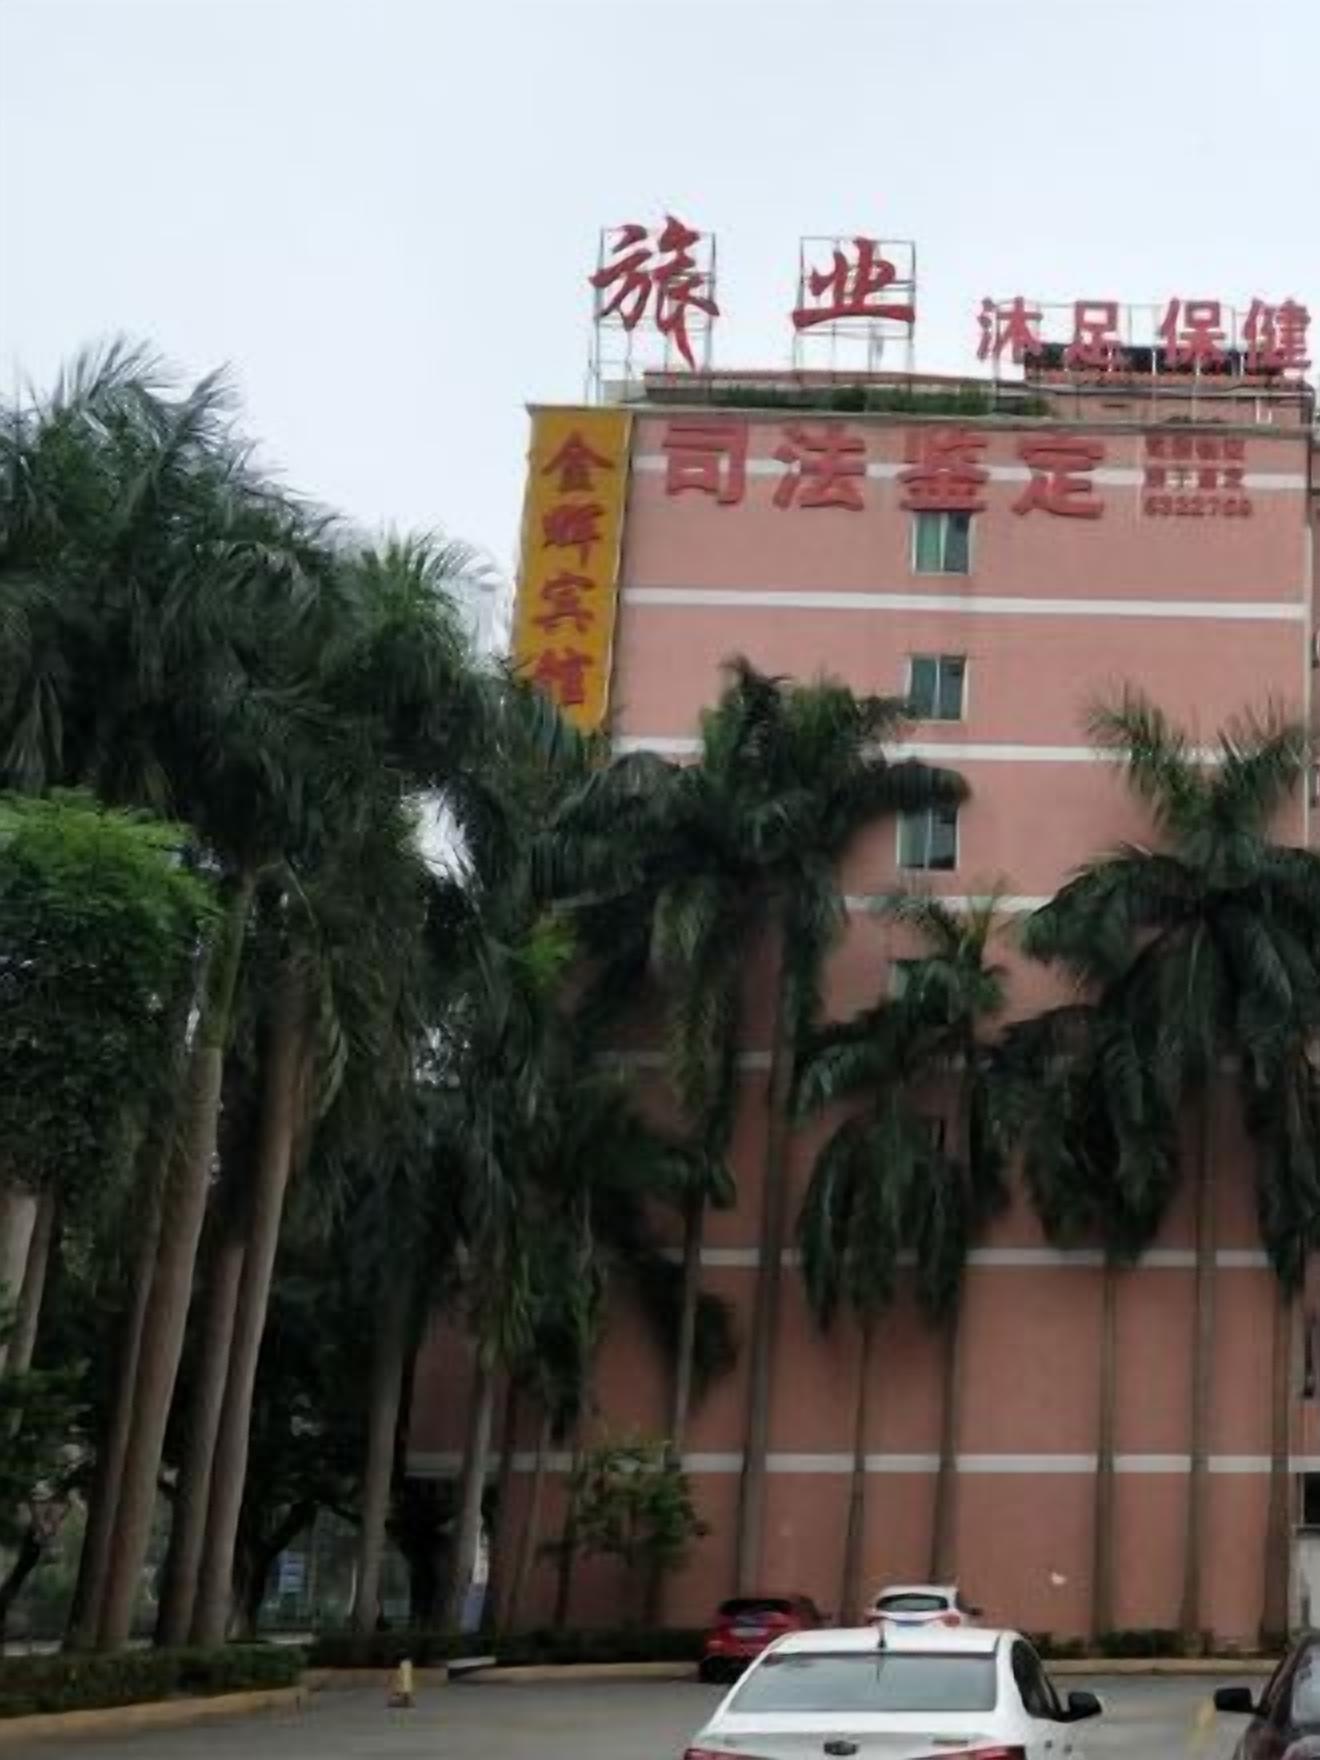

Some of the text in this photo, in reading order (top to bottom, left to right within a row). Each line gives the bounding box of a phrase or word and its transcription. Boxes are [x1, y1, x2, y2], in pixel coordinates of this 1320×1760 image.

[589, 215, 916, 371] 旅业
[976, 296, 1312, 376] 沐足保健
[662, 420, 1104, 520] 司法鉴定
